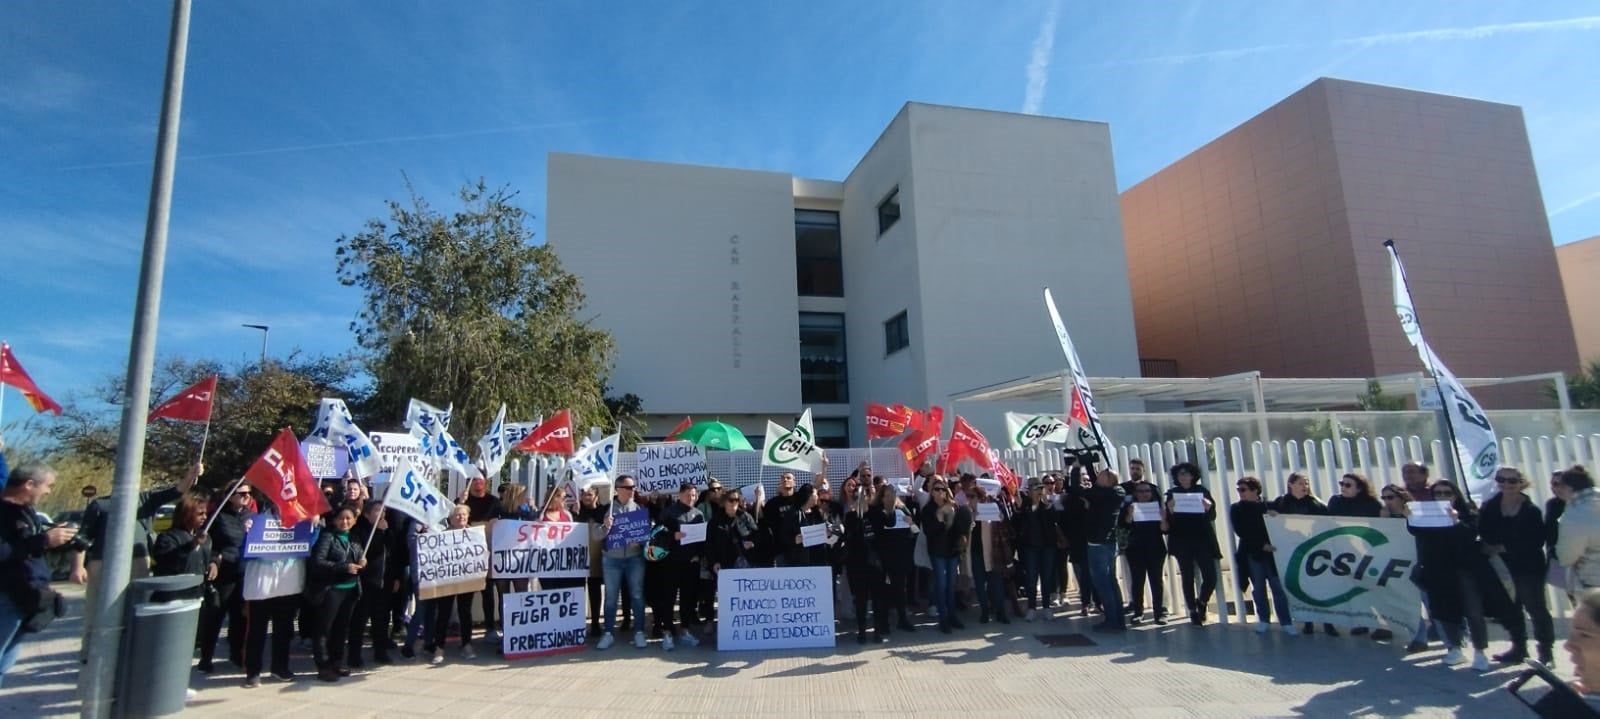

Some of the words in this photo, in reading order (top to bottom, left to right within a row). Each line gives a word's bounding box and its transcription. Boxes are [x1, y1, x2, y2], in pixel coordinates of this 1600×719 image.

[640, 447, 660, 462] SIN
[663, 445, 700, 460] LUCHA
[640, 466, 655, 479] NO
[640, 479, 678, 492] NUESTRA
[418, 533, 447, 550] POR
[453, 530, 472, 545] LA
[517, 524, 572, 542] STOP
[250, 544, 307, 552] IMPORTANTES
[418, 545, 485, 566] DIGNIDAD
[419, 560, 489, 581] ASISTENCIAL
[732, 578, 817, 592] TREBALLADORS
[781, 596, 816, 609] BALEAR
[511, 607, 549, 626] FUGA
[559, 602, 579, 618] DE
[782, 612, 821, 624] SUPORT
[510, 628, 586, 651] PROFESIONALES
[733, 630, 740, 640] A
[745, 630, 757, 641] LA
